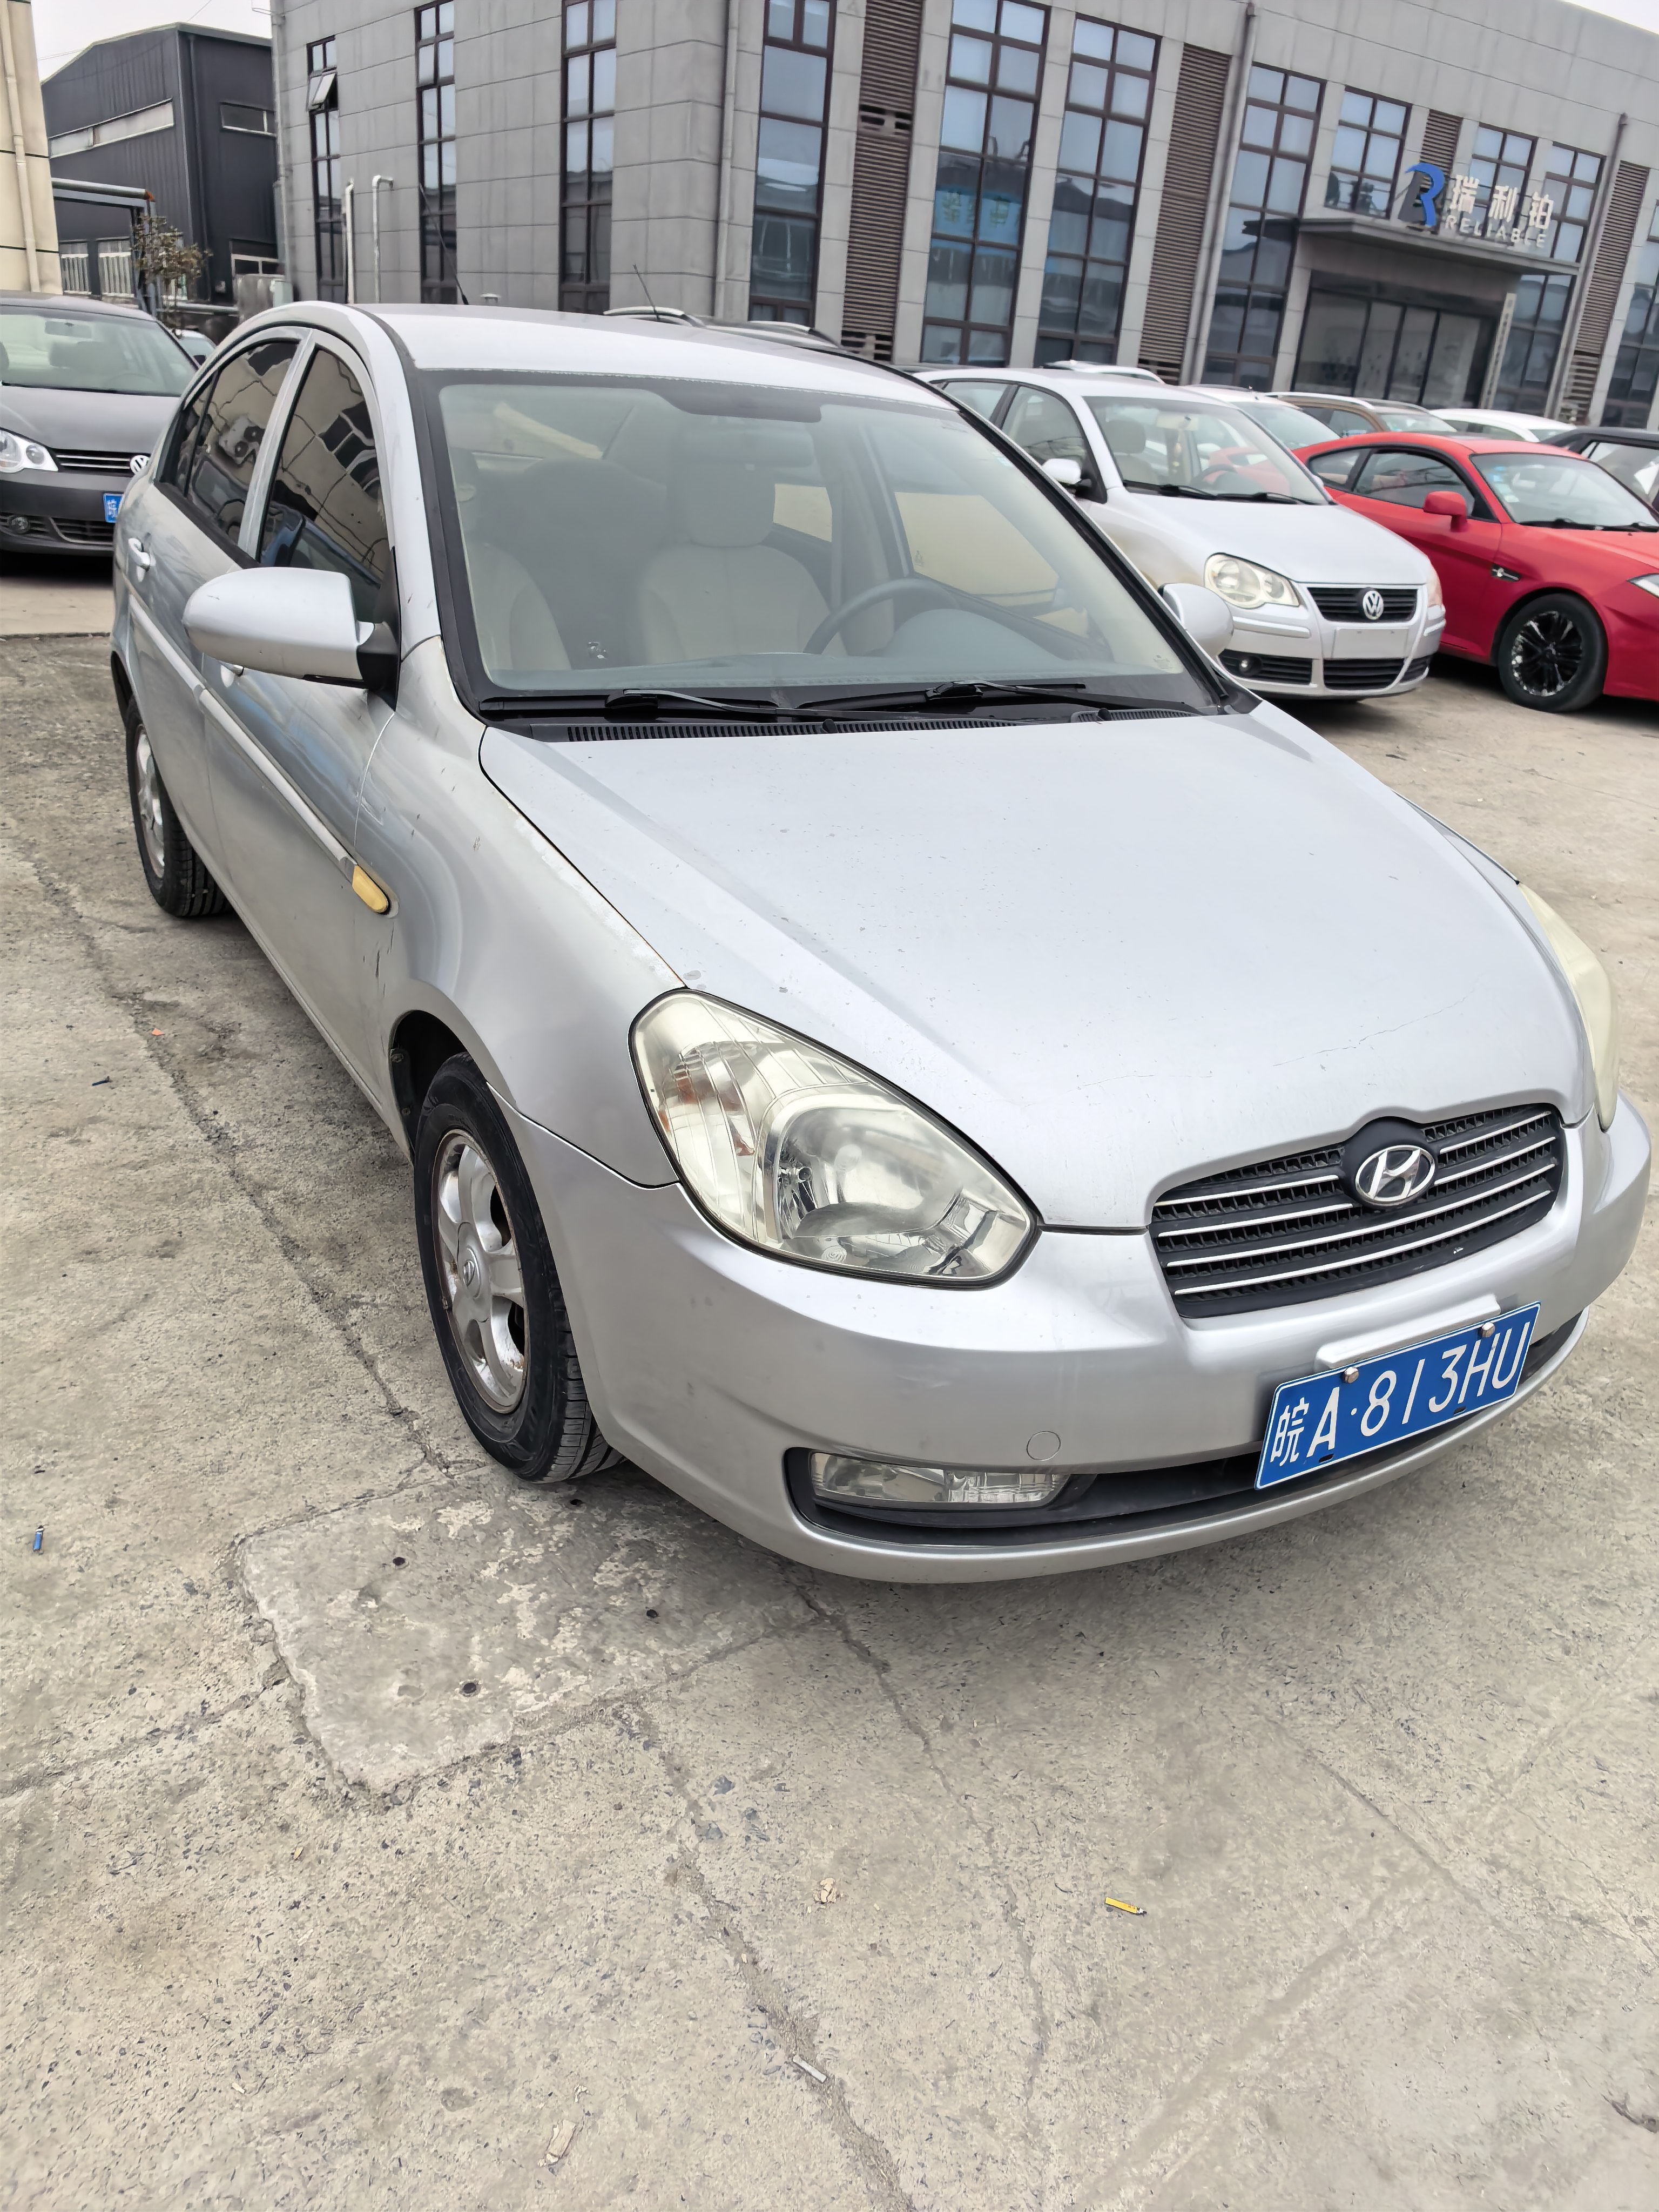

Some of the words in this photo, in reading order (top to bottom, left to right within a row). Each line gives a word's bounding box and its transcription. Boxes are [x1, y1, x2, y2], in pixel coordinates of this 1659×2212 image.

[1450, 174, 1554, 230] 瑞利铂
[1445, 214, 1547, 248] RELIABLE
[1270, 1321, 1530, 1467] 皖A·813HU
